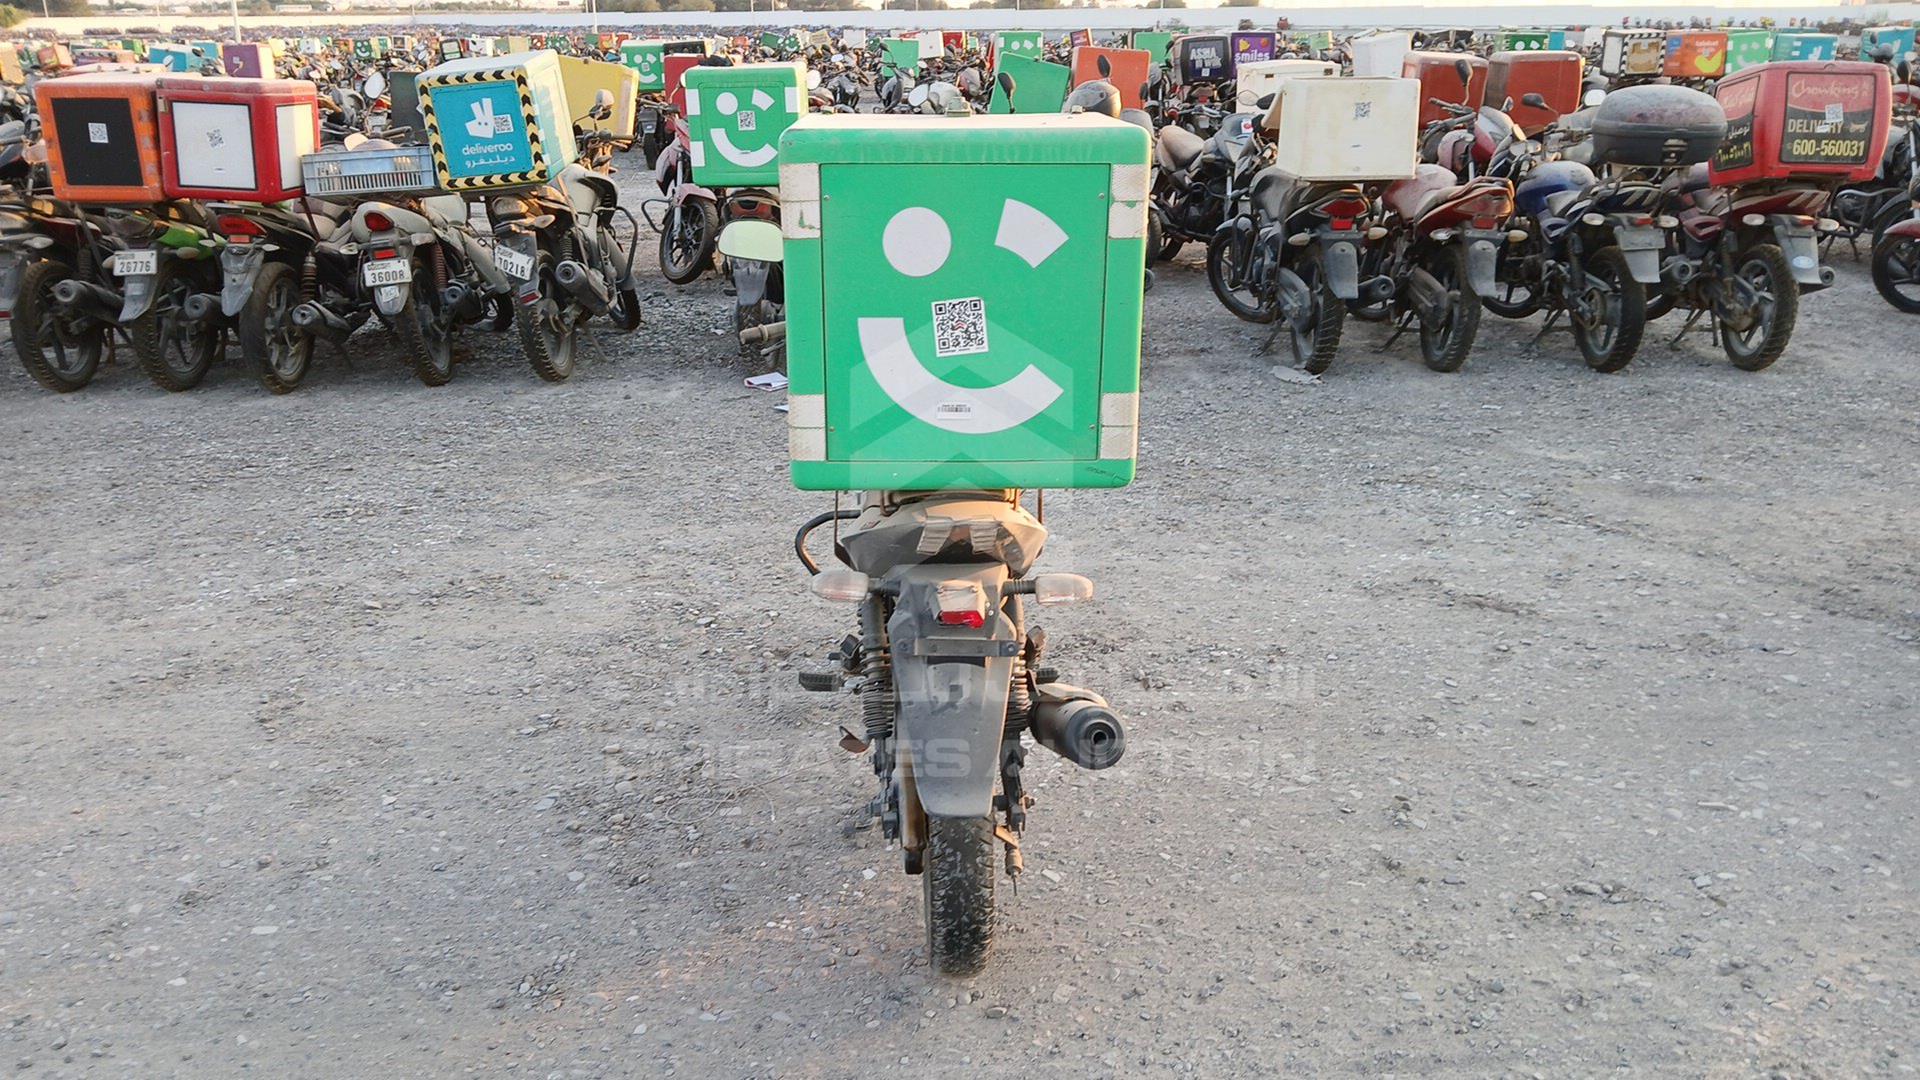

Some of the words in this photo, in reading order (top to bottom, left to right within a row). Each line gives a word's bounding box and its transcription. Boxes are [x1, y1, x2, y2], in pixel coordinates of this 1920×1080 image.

[1234, 49, 1270, 61] smiles
[462, 143, 513, 156] deliveroo
[1793, 139, 1865, 156] 600-560031
[119, 261, 151, 273] 26776
[498, 256, 526, 277] 70218
[371, 269, 405, 284] 36008
